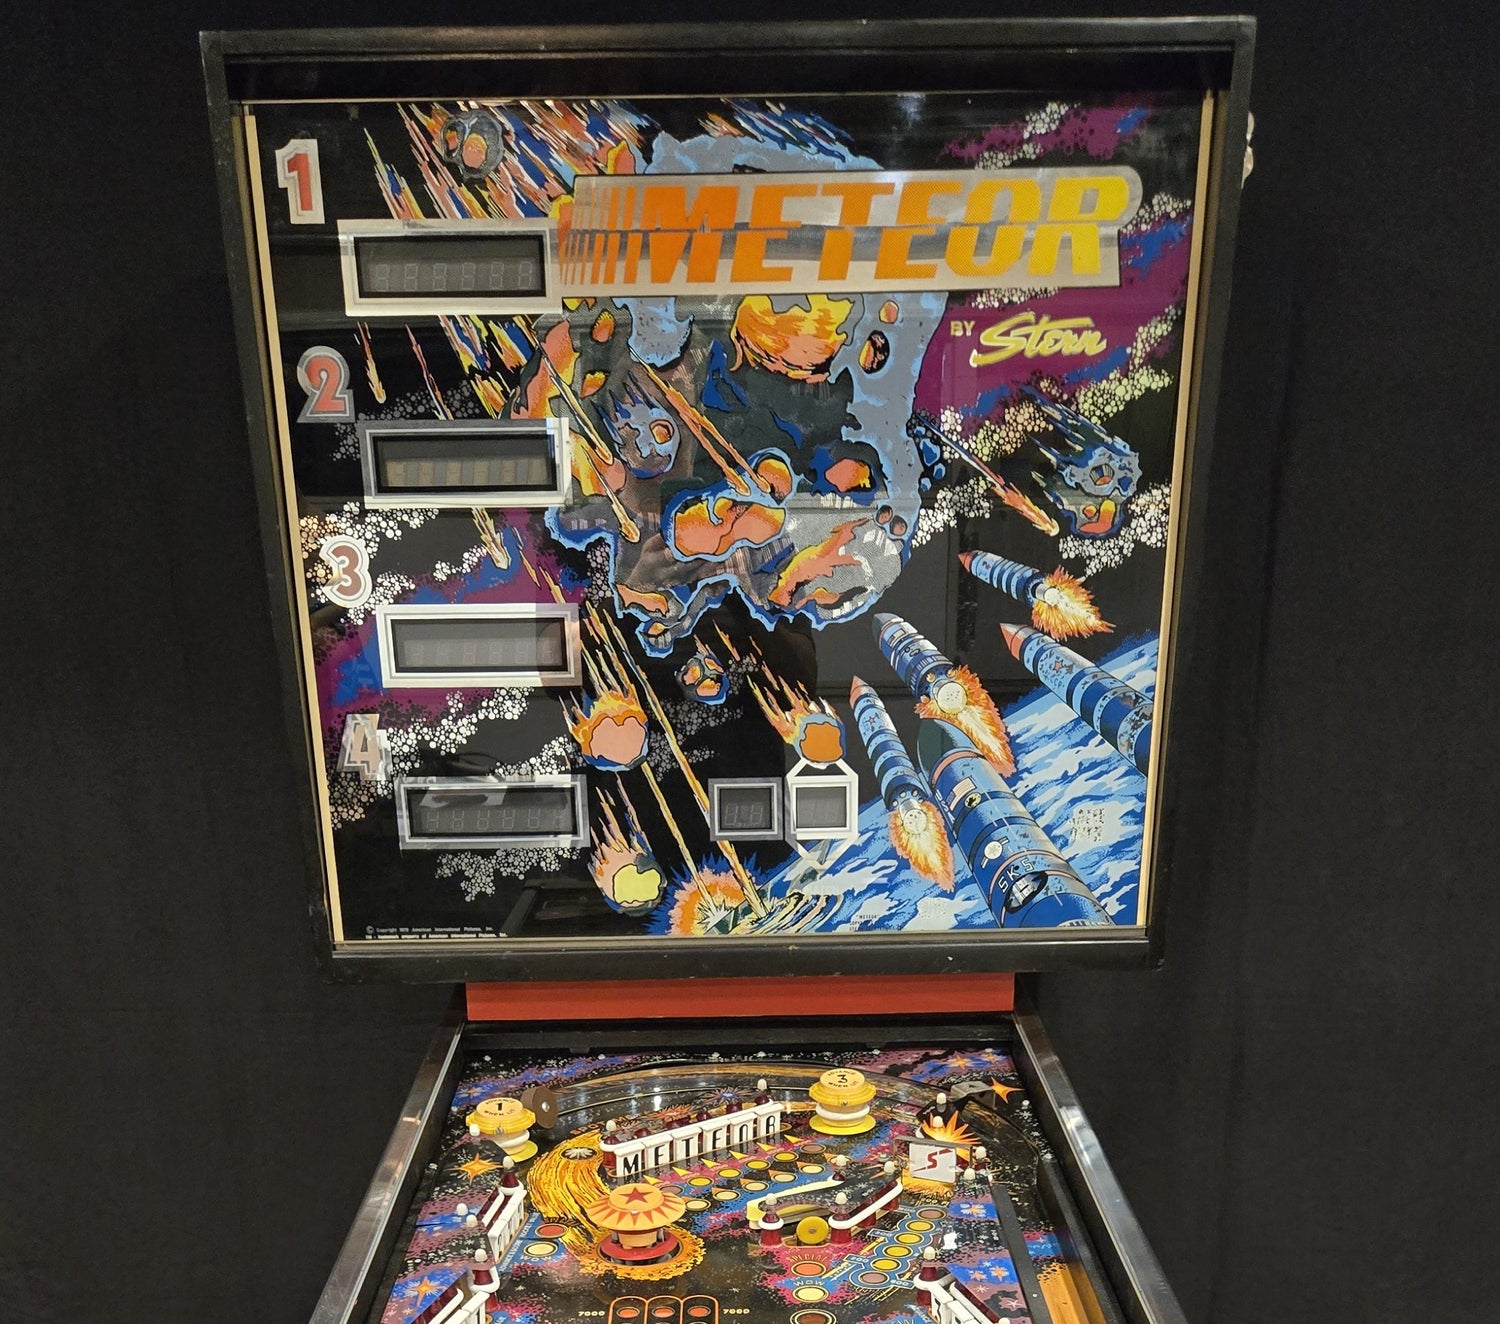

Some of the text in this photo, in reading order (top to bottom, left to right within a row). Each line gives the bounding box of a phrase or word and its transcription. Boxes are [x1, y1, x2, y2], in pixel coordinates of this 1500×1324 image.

[280, 146, 319, 218] 1
[640, 175, 1130, 285] METEOR
[950, 312, 1107, 368] BY Stern
[300, 349, 351, 419] 2
[322, 537, 368, 604] 3
[346, 717, 384, 777] 4
[496, 1102, 503, 1111] 1
[837, 1074, 848, 1083] 3
[793, 1278, 825, 1287] WOW
